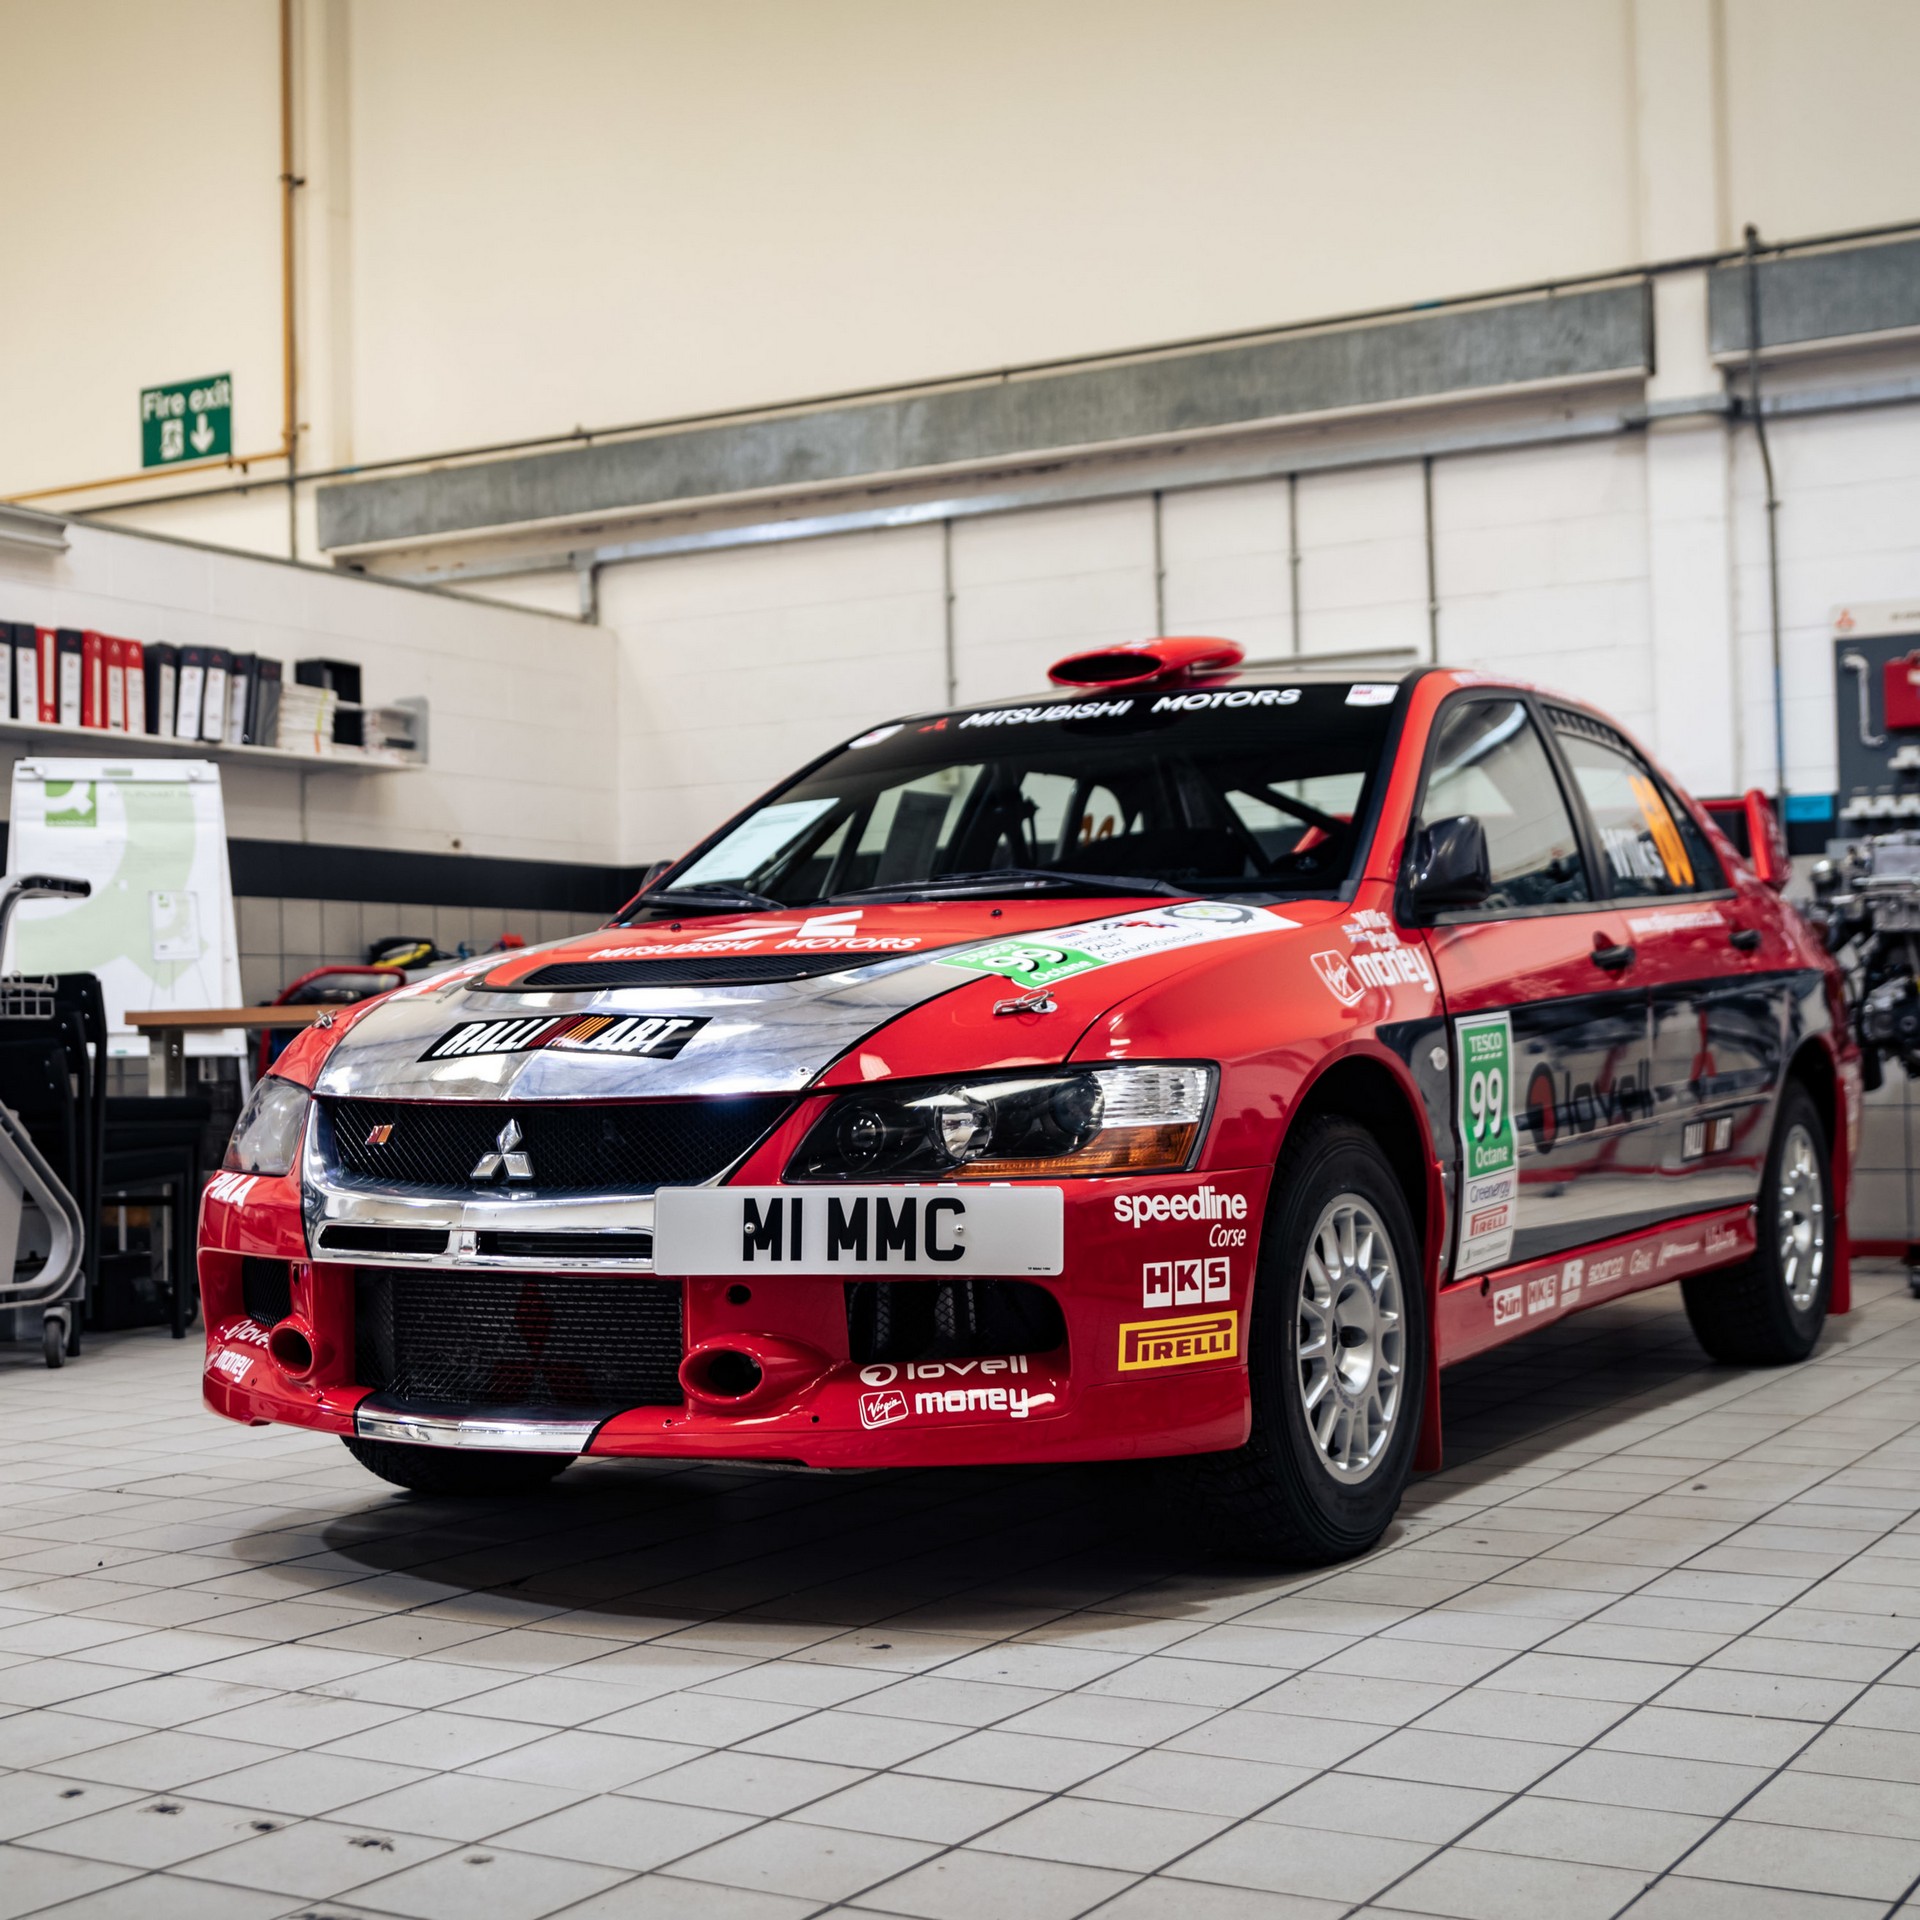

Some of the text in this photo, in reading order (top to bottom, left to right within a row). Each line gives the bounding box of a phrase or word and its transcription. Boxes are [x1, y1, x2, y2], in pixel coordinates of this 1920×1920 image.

[143, 379, 230, 422] Fire exit
[959, 689, 1302, 729] MITSUBISHI MOTORS
[588, 937, 921, 961] MITSUBISHI MOTORS
[982, 948, 1068, 973] 99
[1030, 959, 1093, 981] Octane
[1351, 947, 1436, 993] money
[1469, 1032, 1503, 1054] TESCO
[1470, 1067, 1503, 1141] 99
[1565, 1058, 1654, 1136] lovell
[1475, 1145, 1508, 1169] Octane
[202, 1172, 260, 1208] PIAA
[1470, 1180, 1511, 1204] Greenergy
[1114, 1186, 1247, 1229] speedline
[1470, 1204, 1508, 1237] PIRELLI
[827, 1197, 967, 1262] MMC
[1209, 1223, 1246, 1248] Corse
[1144, 1259, 1229, 1300] HKS
[1125, 1318, 1232, 1363] PIRELLI
[214, 1349, 254, 1383] money
[907, 1355, 1028, 1380] lovell
[867, 1388, 1029, 1420] Virgin money
